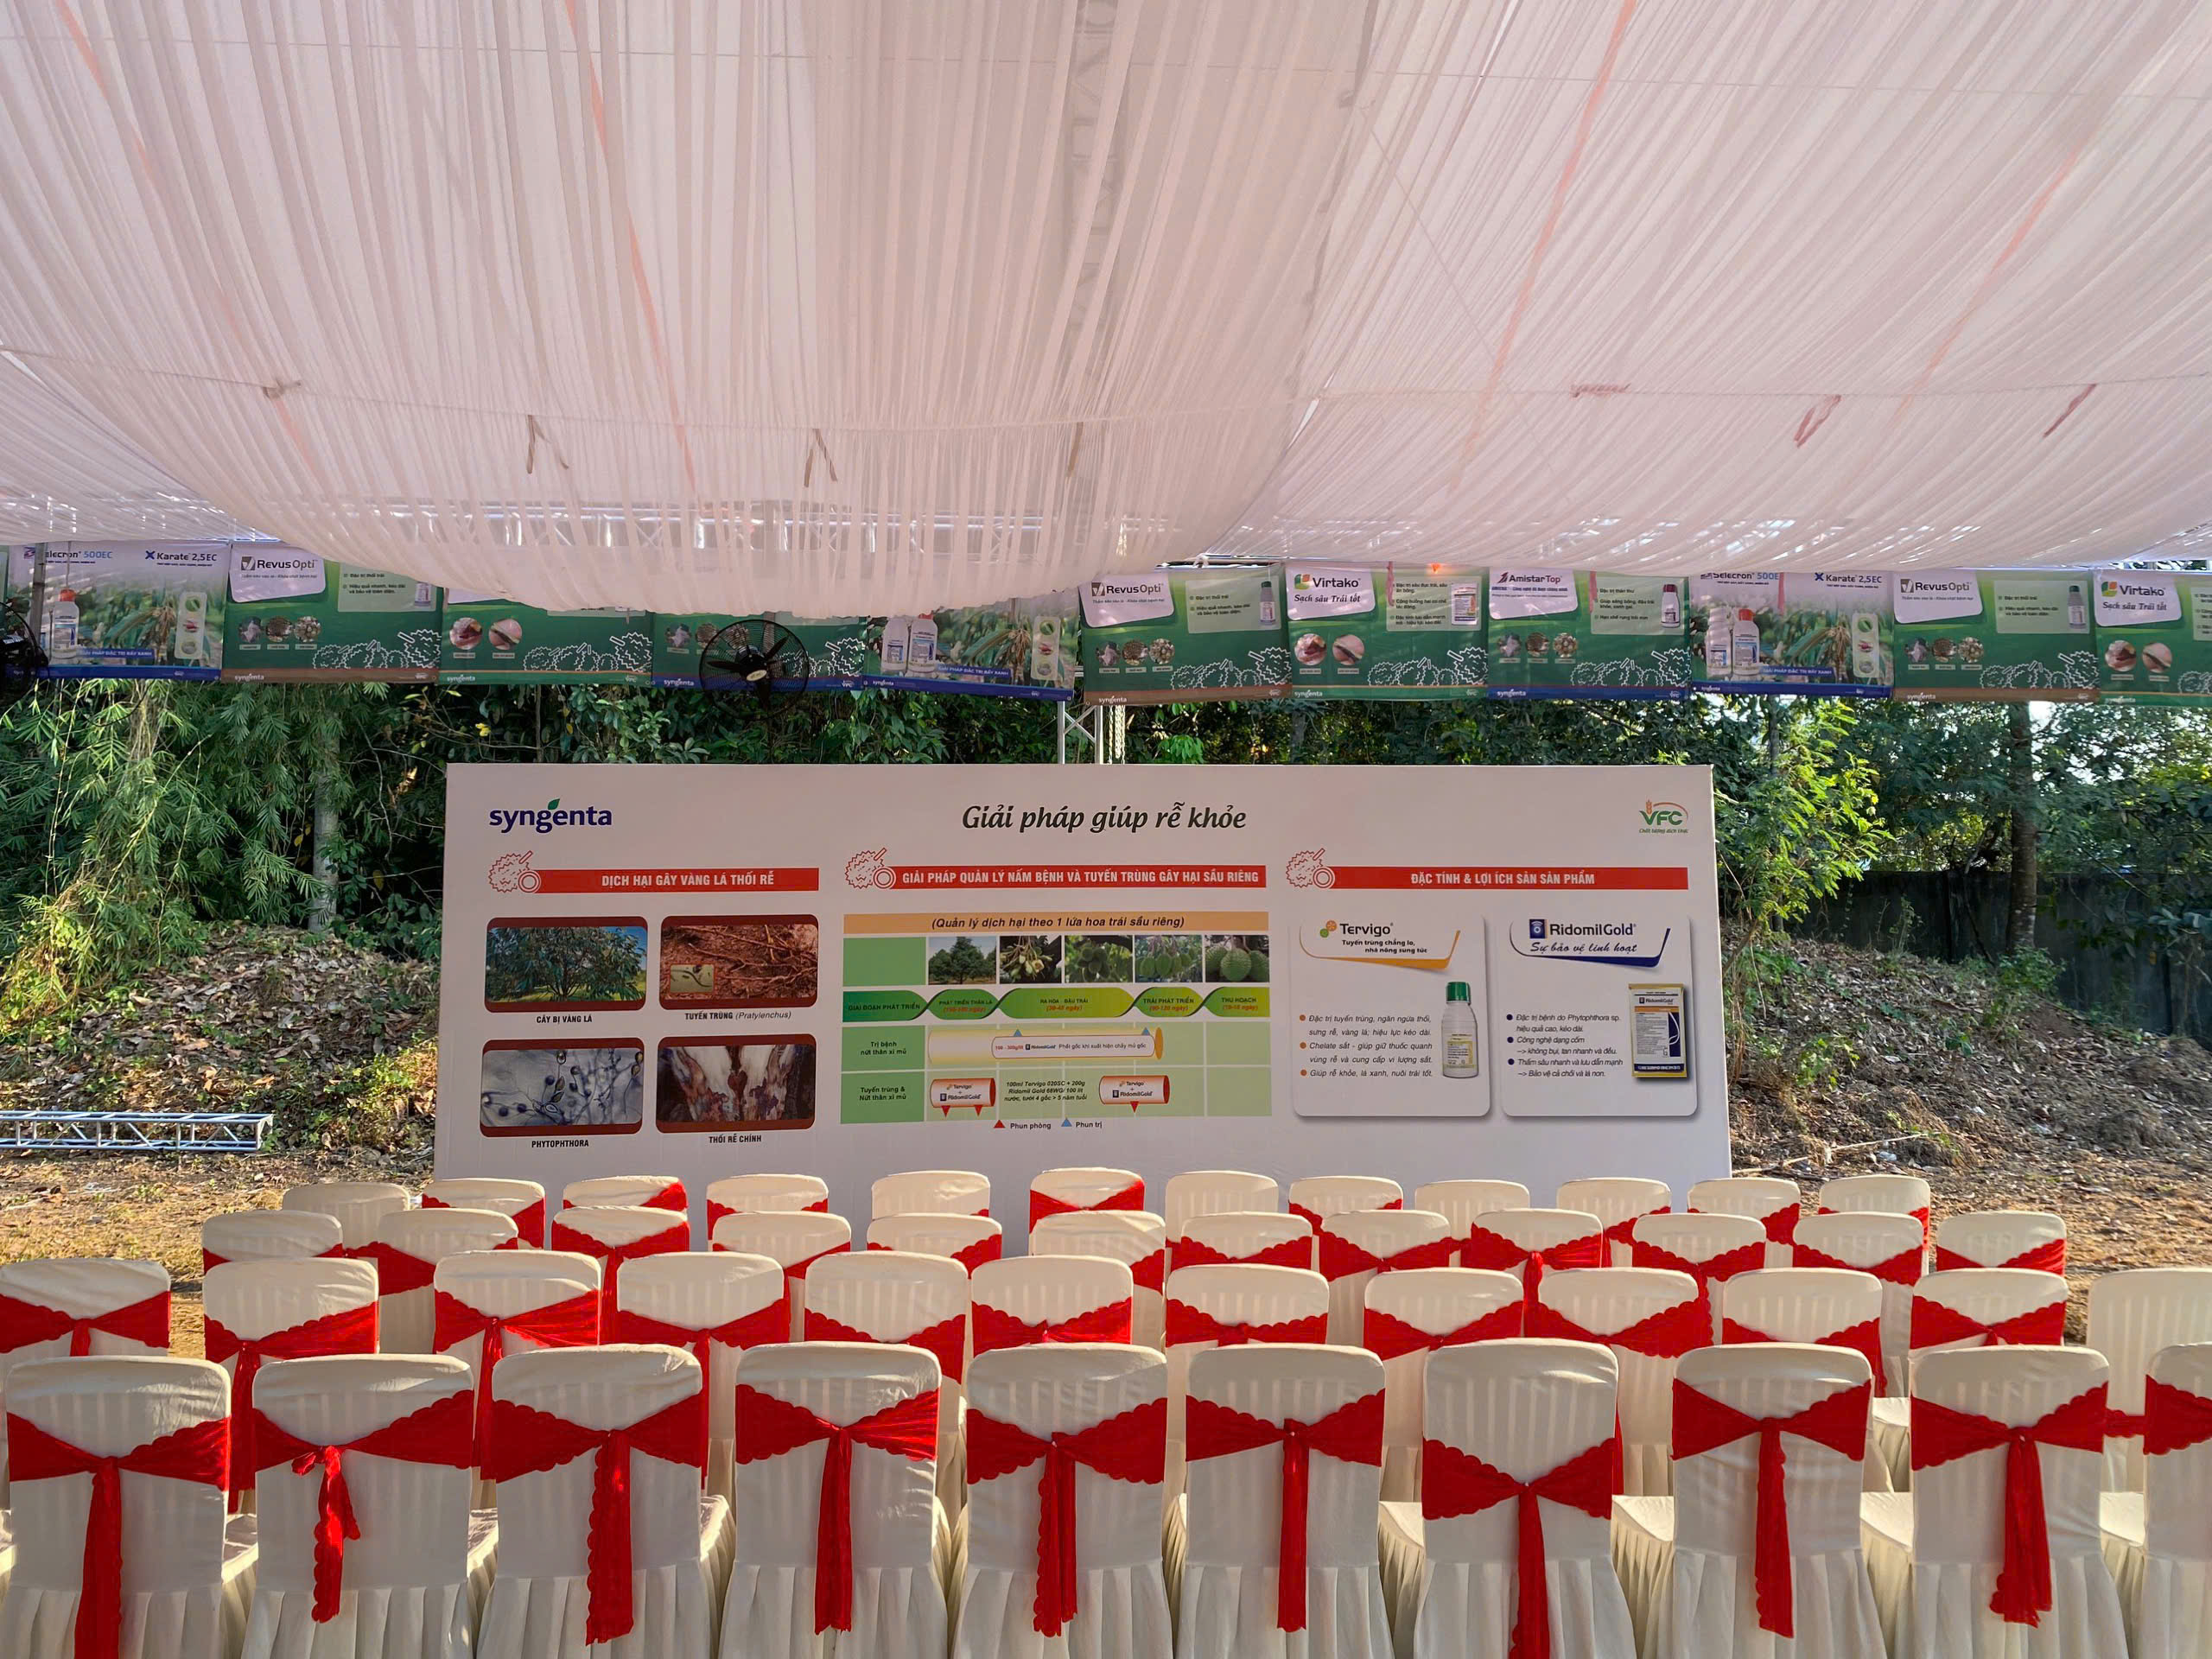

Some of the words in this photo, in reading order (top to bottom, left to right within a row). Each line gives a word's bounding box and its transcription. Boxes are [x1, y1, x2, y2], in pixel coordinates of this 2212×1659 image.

[43, 550, 79, 559] elecron
[156, 552, 188, 561] Karate
[192, 553, 218, 562] 2,5EC
[257, 560, 315, 571] RevusOpti
[1313, 577, 1359, 588] Virtako
[1859, 575, 1882, 584] 2,5EC
[1106, 583, 1161, 595] RevusOpti
[1915, 582, 1970, 594] RevusOpti
[2120, 585, 2164, 596] Virtako
[1294, 594, 1313, 603] Sạch
[1331, 594, 1347, 603] Trái
[1350, 593, 1361, 602] tốt
[234, 674, 264, 683] syngenta
[664, 678, 695, 688] syngenta
[1098, 696, 1128, 704] syngenta
[1294, 690, 1323, 699] syngenta
[1497, 690, 1527, 699] syngenta
[489, 804, 612, 833] syngenta
[962, 804, 1014, 829] Giải
[1019, 804, 1084, 834] pháp
[1090, 804, 1148, 834] giúp
[1154, 801, 1185, 829] rễ
[1186, 804, 1247, 829] khỏe
[1639, 810, 1682, 825] VFC
[601, 874, 630, 889] DỊCH
[632, 874, 652, 889] HẠI
[655, 872, 678, 886] GÂY
[680, 872, 711, 886] VÀNG
[713, 872, 728, 886] LÁ
[729, 870, 756, 886] THỐI
[760, 870, 775, 886] RỄ
[902, 869, 925, 884] GIẢI
[927, 869, 957, 884] PHÁP
[959, 868, 989, 884] QUẢN
[992, 869, 1005, 883] LÝ
[1007, 868, 1033, 883] NẤM
[1034, 868, 1064, 885] BỆNH
[1066, 868, 1082, 882] VÀ
[1084, 868, 1118, 882] TUYẾN
[1120, 868, 1156, 882] TRÙNG
[1159, 868, 1180, 882] GÂY
[1182, 871, 1200, 885] HẠI
[1226, 868, 1259, 882] RIÊNG
[1410, 871, 1433, 887] ĐẶC
[1434, 871, 1461, 884] TÍNH
[1463, 873, 1472, 884] &
[1474, 872, 1492, 887] LỢI
[1494, 871, 1514, 885] ÍCH
[1516, 870, 1537, 885] SẢN
[1539, 870, 1561, 885] SẢN
[1563, 869, 1595, 885] PHẨM
[931, 917, 965, 931] (Quản
[968, 917, 980, 931] lý
[981, 917, 1006, 929] dịch
[1008, 917, 1027, 929] hại
[1028, 917, 1053, 927] theo
[1057, 917, 1062, 927] 1
[1065, 916, 1083, 927] lứa
[1084, 917, 1106, 927] hoa
[1109, 916, 1128, 927] trái
[1152, 916, 1185, 929] riêng)
[1549, 922, 1634, 936] RidomilGold
[1338, 923, 1392, 938] Tervigo
[1530, 942, 1548, 954] Sự
[1551, 942, 1569, 951] bảo
[1573, 944, 1585, 954] vệ
[1614, 943, 1637, 954] hoạt
[537, 1014, 551, 1024] CÂY
[553, 1016, 561, 1025] BỊ
[563, 1014, 582, 1023] VÀNG
[584, 1014, 593, 1023] LÁ
[685, 1011, 708, 1020] TUYẾN
[735, 1011, 791, 1020] (Pratylenchus)
[1030, 1122, 1052, 1131] phòng
[532, 1140, 589, 1148] PHYTOPHTHORA
[709, 1135, 726, 1143] THỐI
[728, 1135, 739, 1143] RỄ
[741, 1134, 761, 1142] CHÍNH
